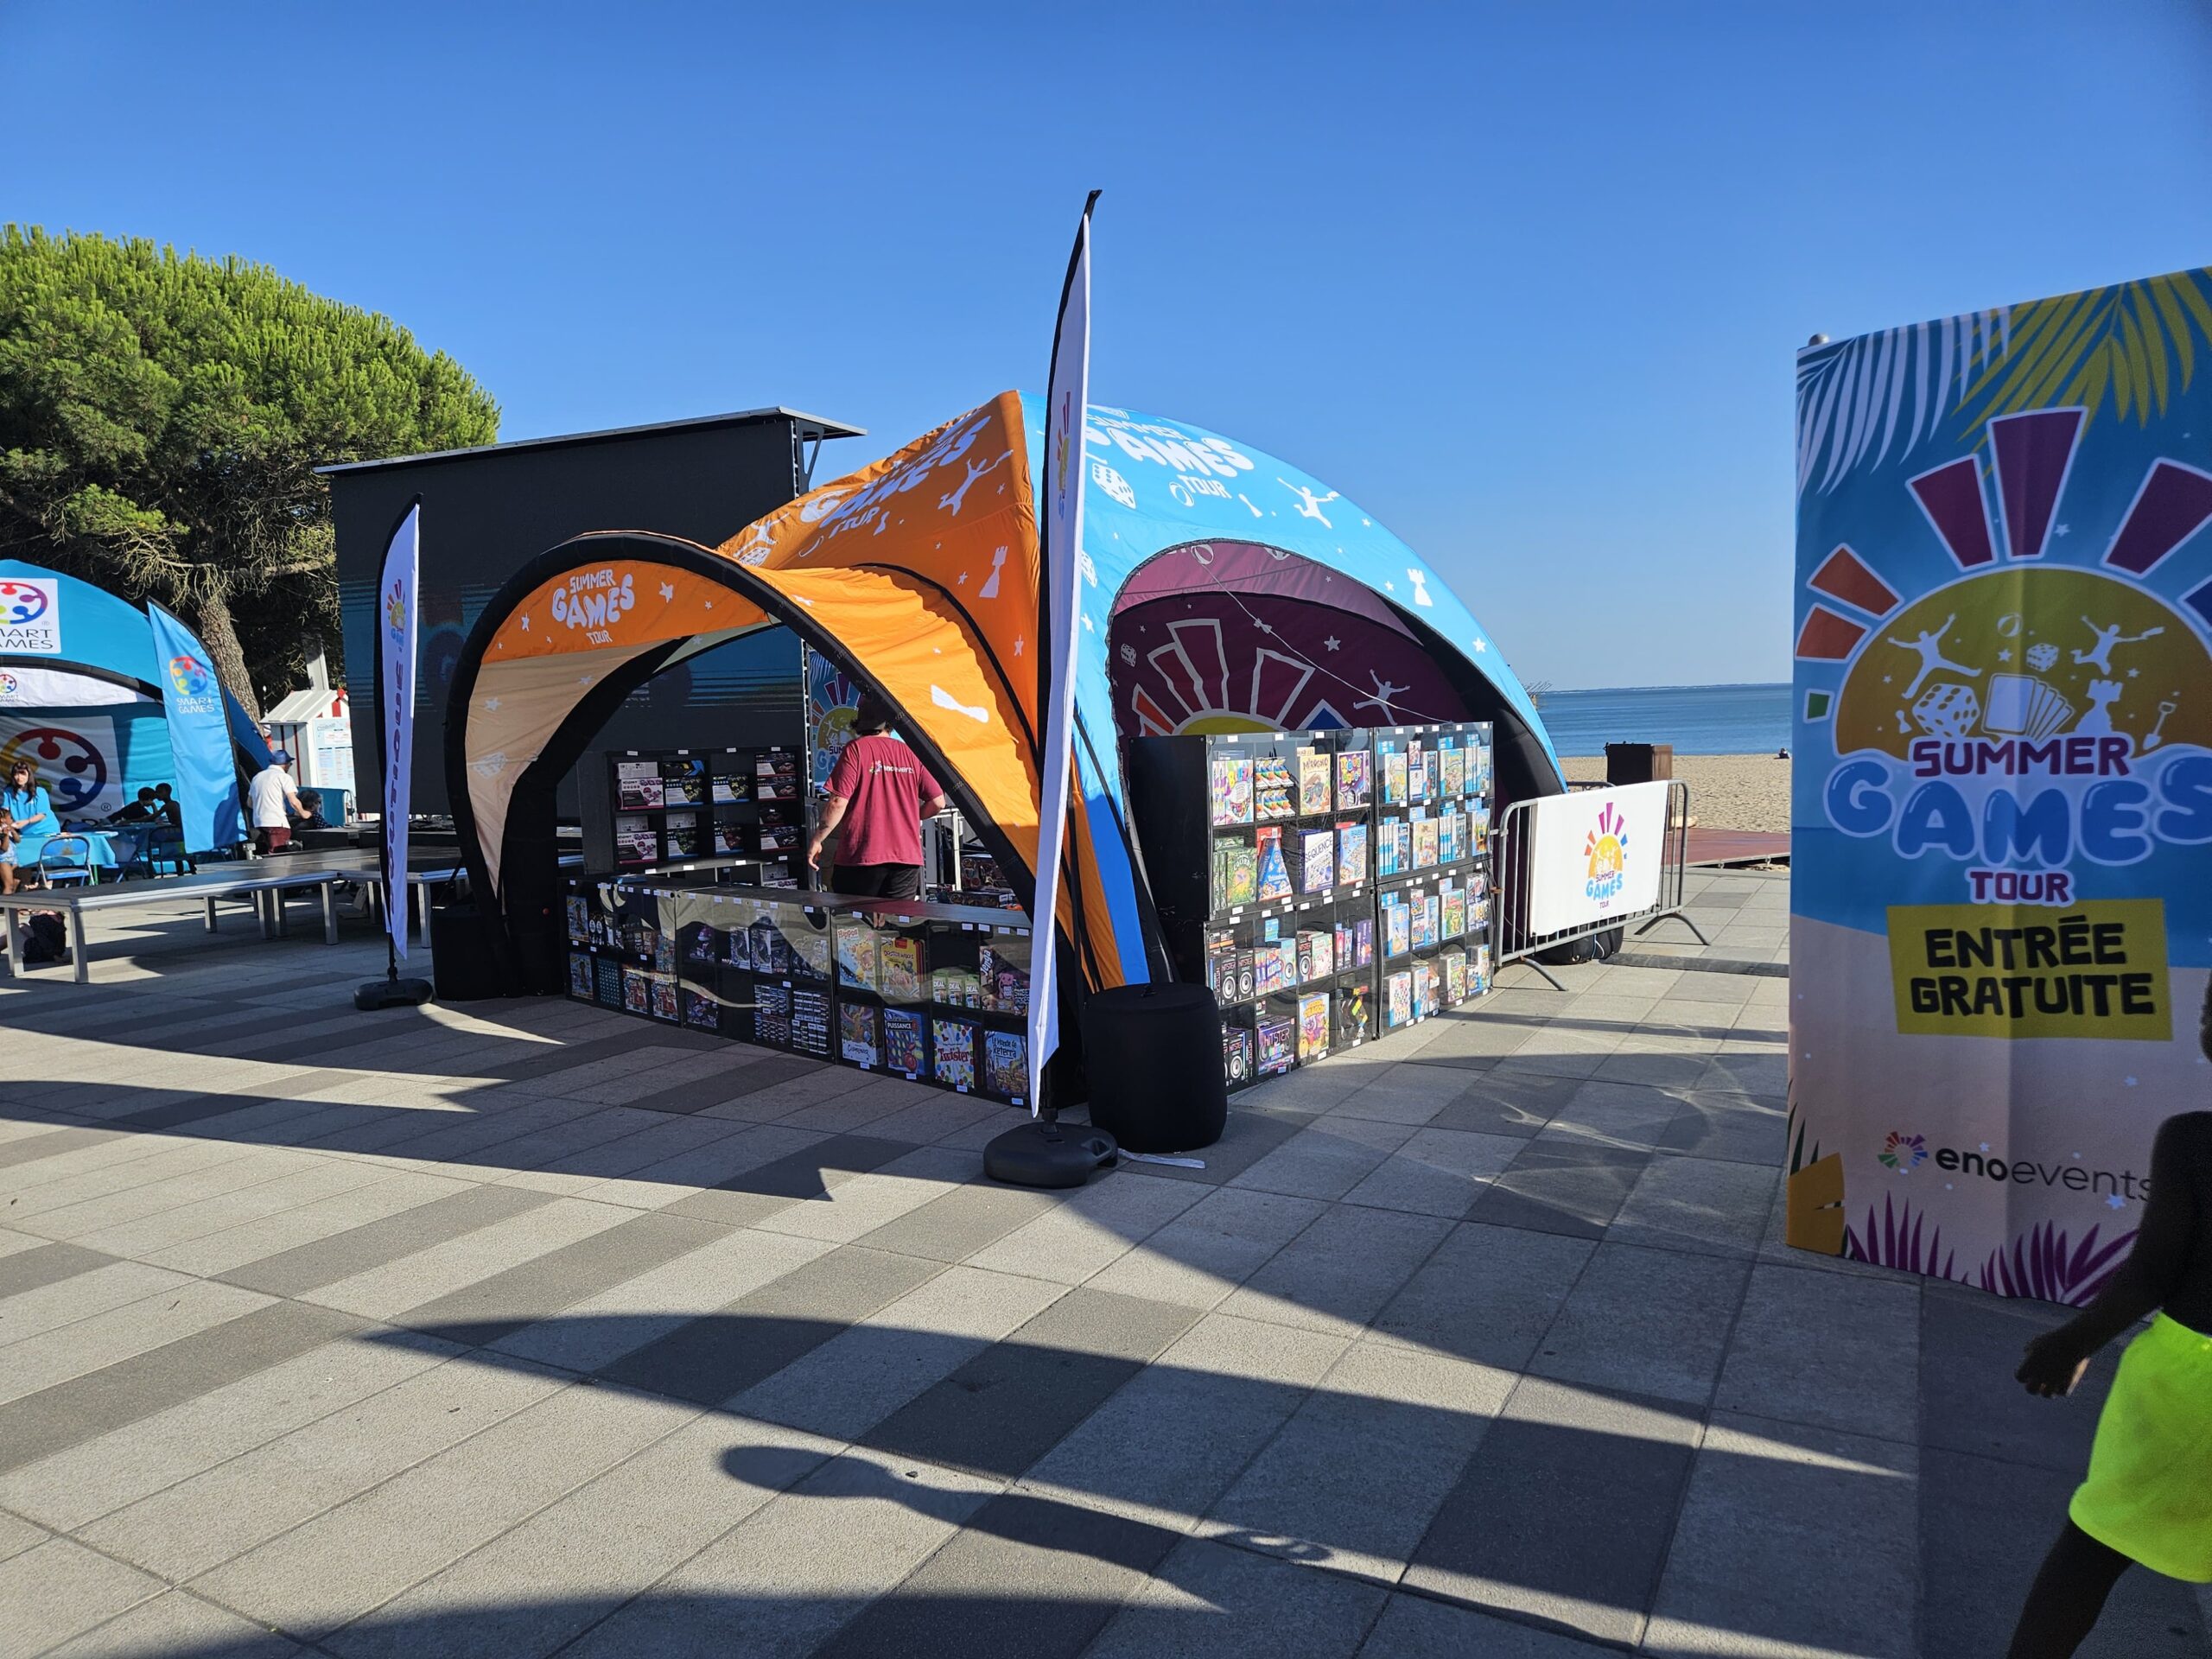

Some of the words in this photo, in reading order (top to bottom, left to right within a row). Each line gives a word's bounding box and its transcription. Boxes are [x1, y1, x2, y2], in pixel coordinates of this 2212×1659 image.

[1176, 474, 1232, 499] TOUR
[570, 569, 617, 594] SUMMER
[552, 574, 635, 629] GAMES
[0, 628, 53, 639] ART
[0, 639, 54, 650] MES
[586, 630, 613, 645] TOUR
[179, 704, 214, 714] GAMES
[1912, 736, 2131, 778] SUMMER
[1825, 754, 2212, 866] GAMES
[1305, 836, 1333, 862] SEQUENCE
[1586, 873, 1623, 900] GAMES
[1969, 871, 2069, 903] TOUR
[1925, 914, 2127, 970] ENTRÉE
[980, 950, 993, 976] Jenga
[1910, 972, 2156, 1019] GRATUITE
[938, 1047, 969, 1062] Twister
